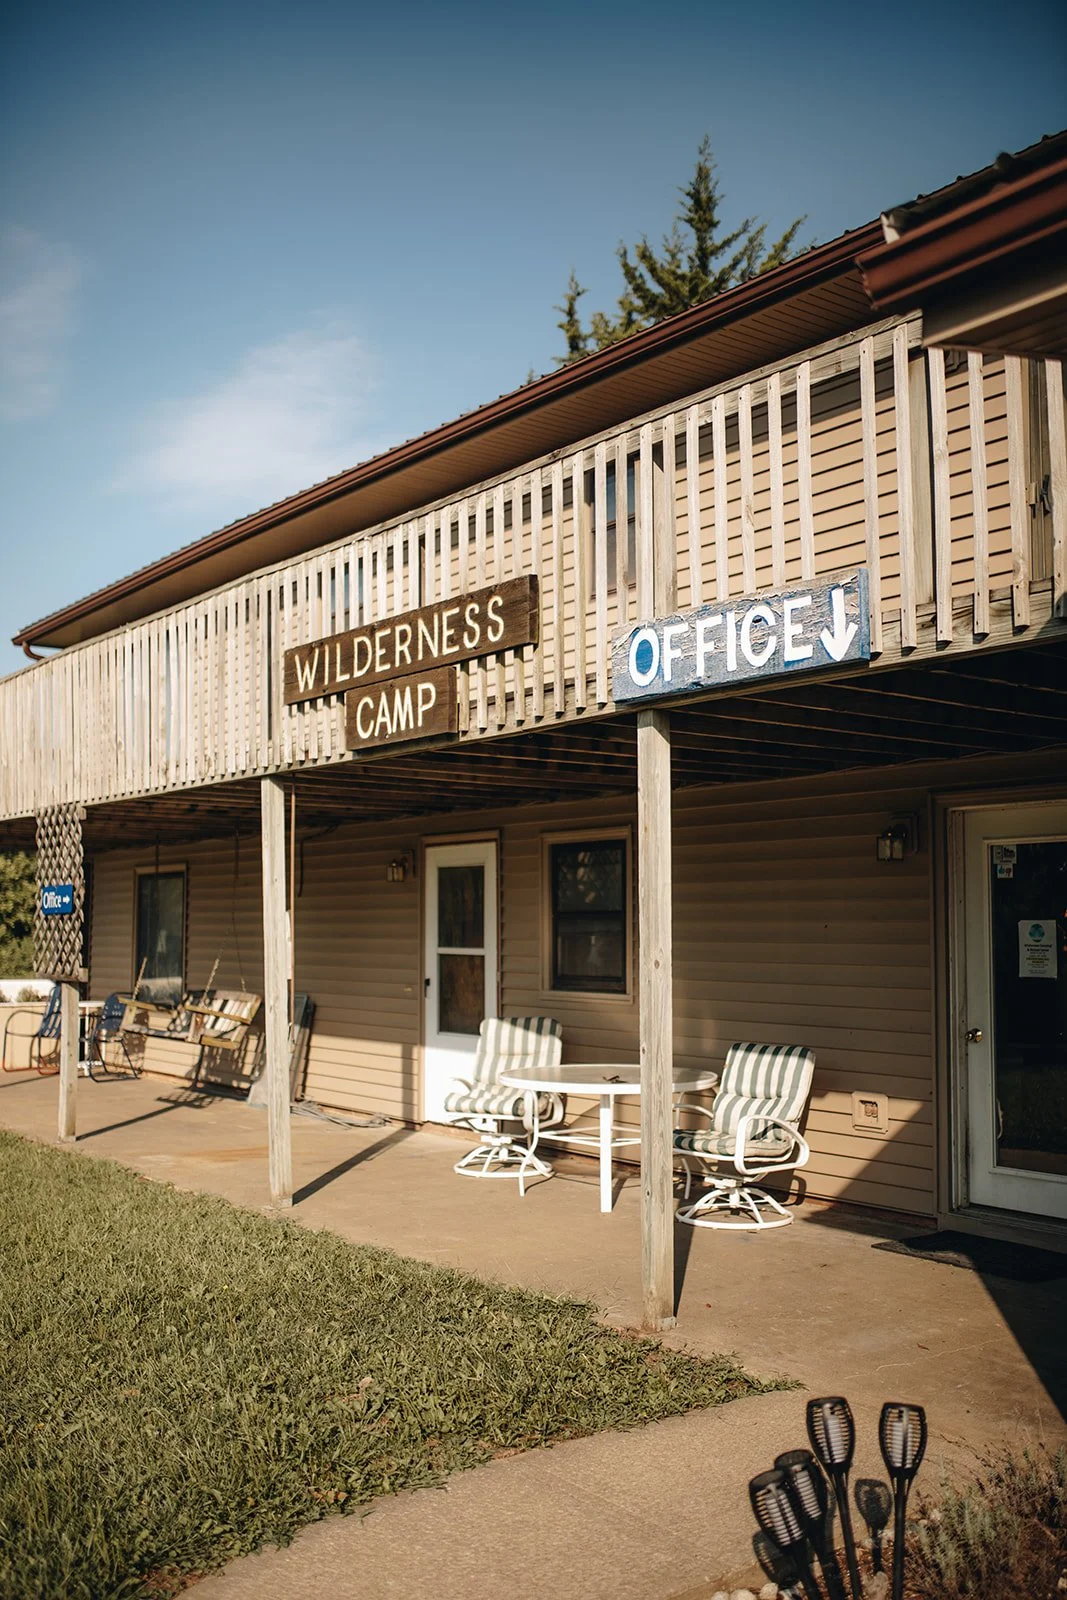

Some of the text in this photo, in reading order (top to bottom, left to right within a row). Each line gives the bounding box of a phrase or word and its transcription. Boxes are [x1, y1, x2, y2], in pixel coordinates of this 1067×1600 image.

[294, 595, 504, 693] WILDERNESS
[629, 596, 813, 687] OFFICE
[356, 682, 436, 739] CAMP
[43, 891, 61, 909] Office
